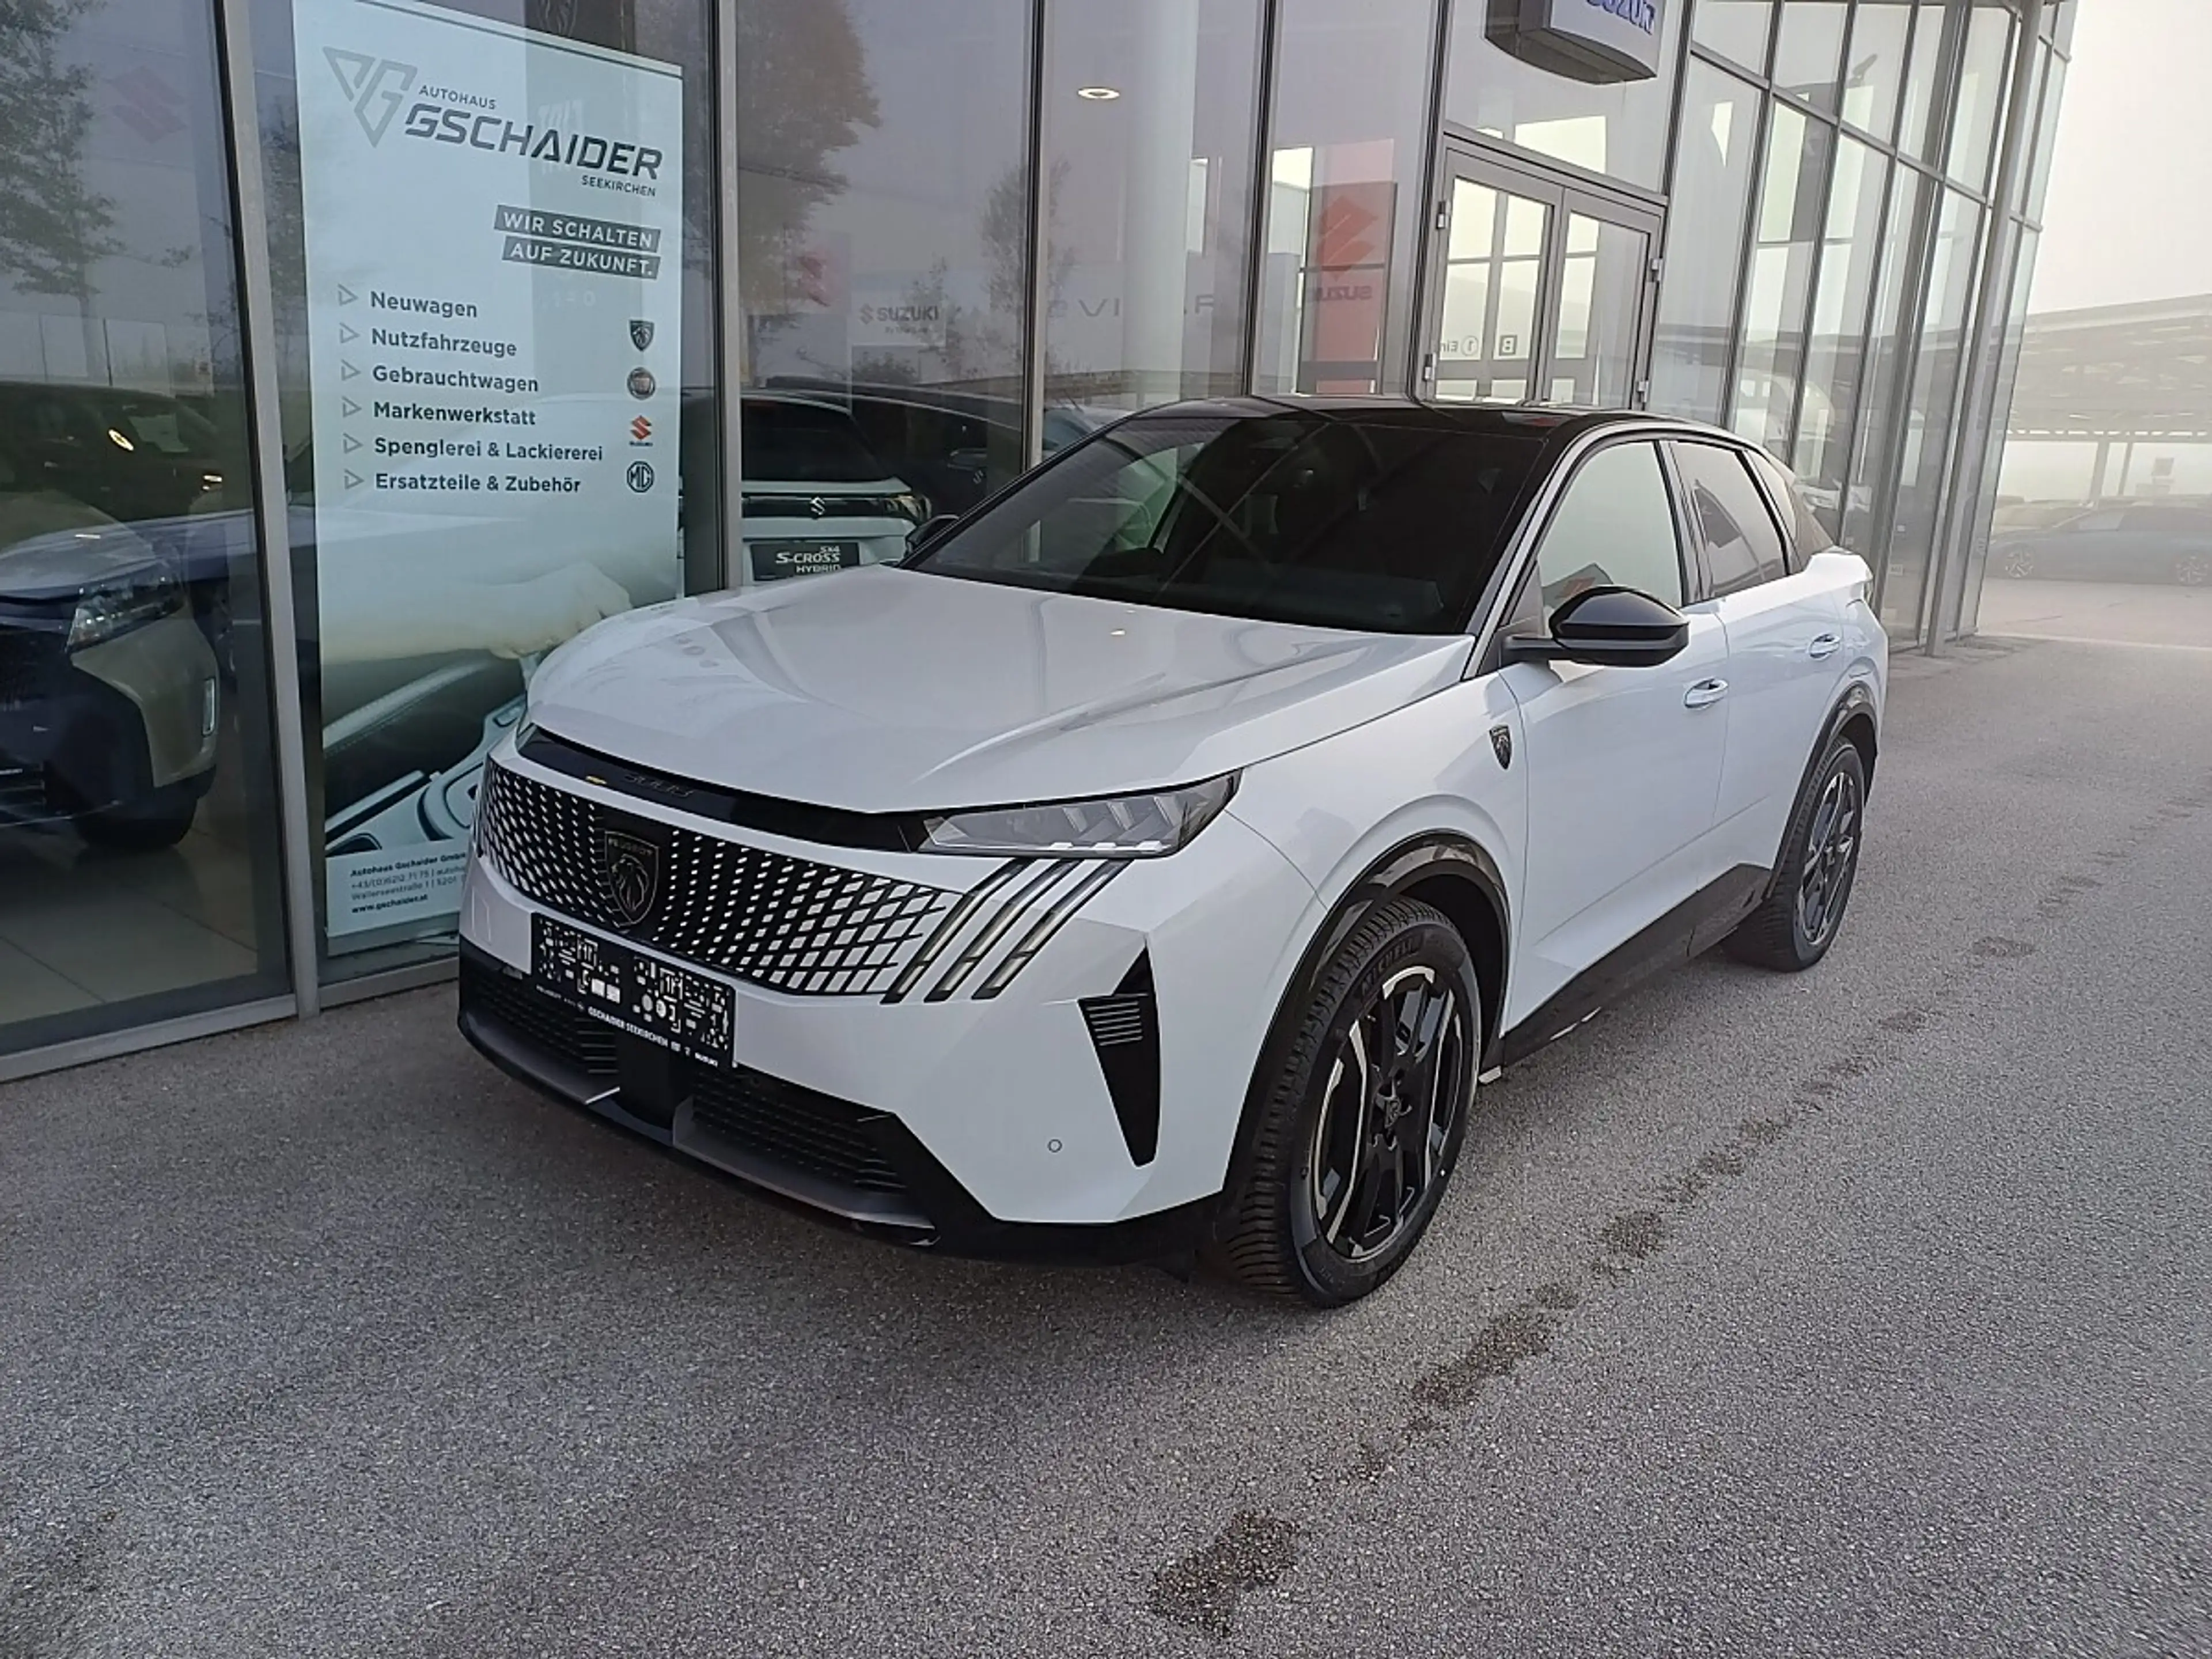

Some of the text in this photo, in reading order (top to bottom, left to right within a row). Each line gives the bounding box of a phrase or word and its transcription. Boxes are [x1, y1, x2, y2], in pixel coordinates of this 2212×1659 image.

[418, 84, 497, 109] AUTOHAUS
[405, 103, 663, 179] GSCHAIDER
[581, 175, 656, 196] SEEKIRCHEN
[503, 212, 653, 248] WIR SCHALTEN
[509, 243, 653, 276] AUF ZUKUNFT.
[370, 291, 478, 319] Neuwagen
[876, 305, 940, 322] SUZUKI
[372, 328, 517, 358] Nutzfahrzeuge
[372, 365, 539, 393] Gebrauchtwagen
[373, 402, 536, 426] Markenwerkstatt
[374, 438, 603, 461] Spenglerei & Lackiererei
[376, 473, 581, 493] Ersatzteile & Zubehör
[775, 552, 840, 565] S-CROSS
[350, 865, 393, 877] Autohaus
[395, 856, 438, 870] Gschaider
